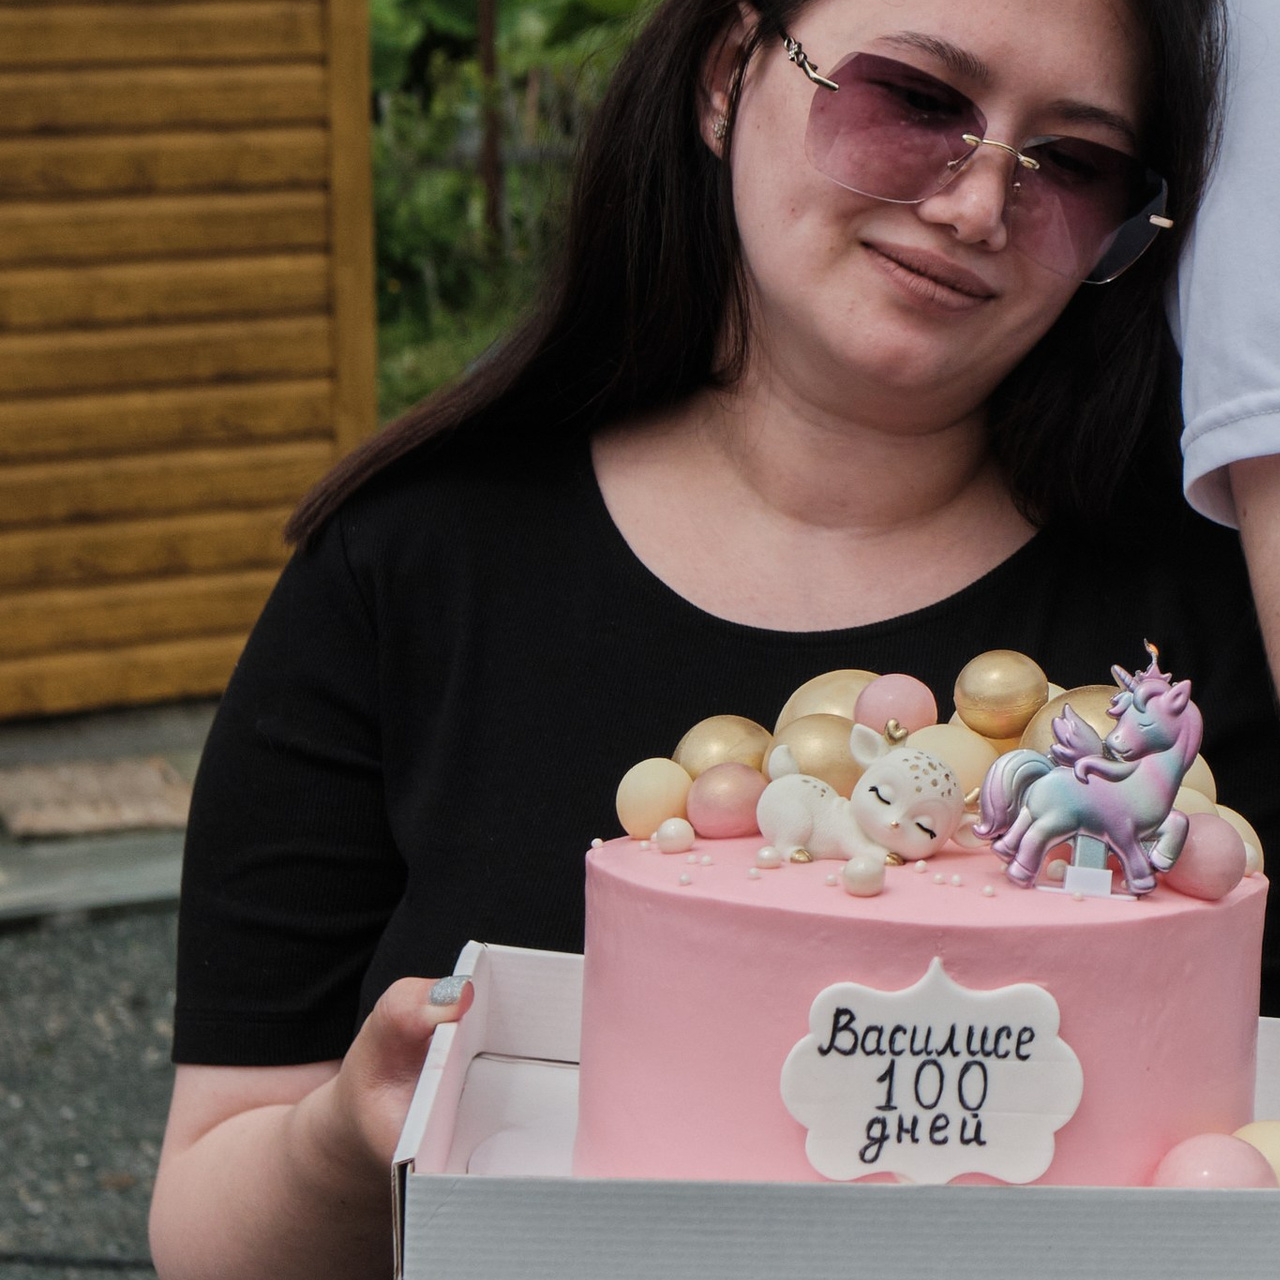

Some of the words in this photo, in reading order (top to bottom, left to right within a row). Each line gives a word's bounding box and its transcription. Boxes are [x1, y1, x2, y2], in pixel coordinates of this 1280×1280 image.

[817, 1006, 1036, 1061] Василисе
[875, 1057, 989, 1112] 100
[858, 1111, 988, 1164] дней
